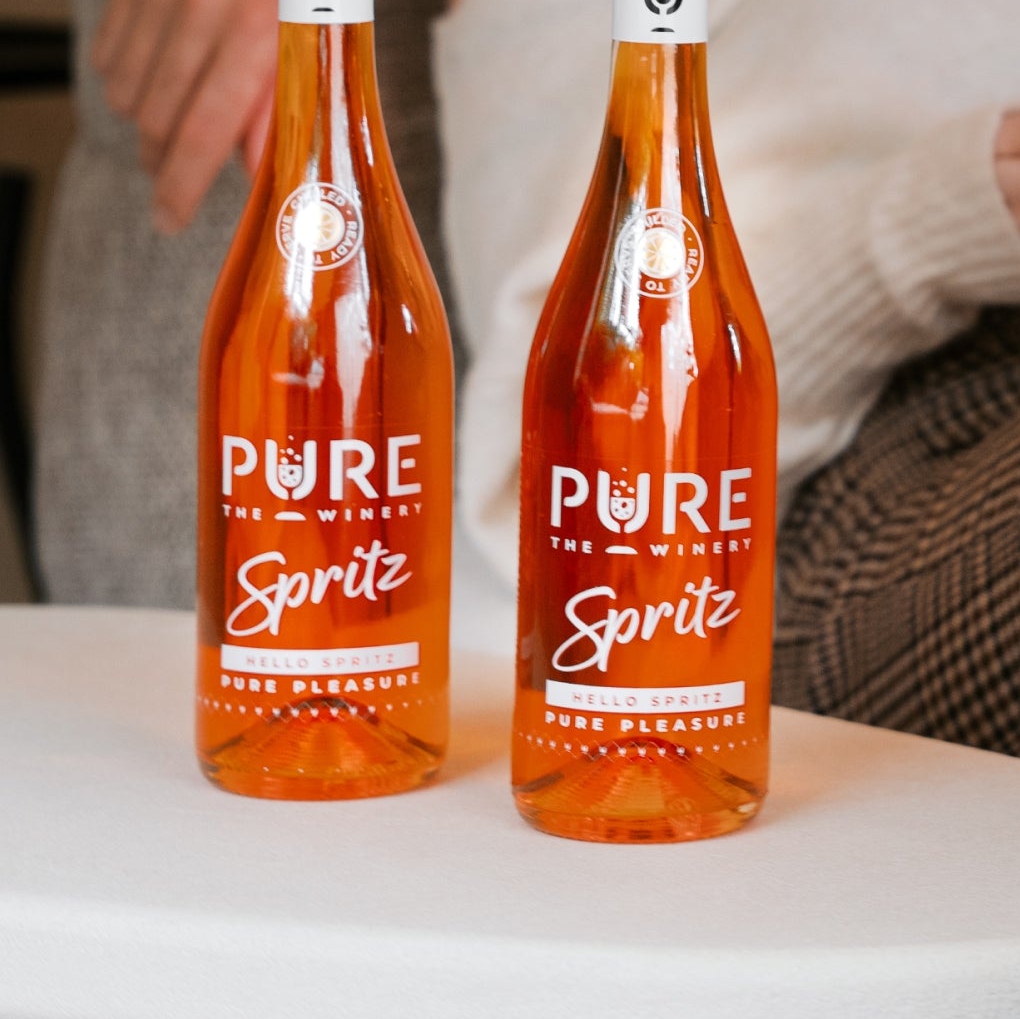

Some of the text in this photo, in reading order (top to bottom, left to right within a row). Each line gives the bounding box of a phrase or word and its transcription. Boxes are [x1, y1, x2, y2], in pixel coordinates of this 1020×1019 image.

[331, 220, 359, 261] READY
[645, 279, 666, 292] TO
[222, 434, 422, 501] PURE
[550, 465, 752, 535] PURE
[221, 502, 422, 522] THE WINERY
[549, 535, 753, 557] THE WINERY
[226, 539, 413, 637] Spritz
[551, 575, 741, 672] Spritz
[245, 652, 396, 669] HELLO SPRITZ
[220, 671, 421, 694] PURE PLEASURE
[570, 691, 723, 707] HELLO SPRITZ
[544, 710, 746, 733] PURE PLEASURE
